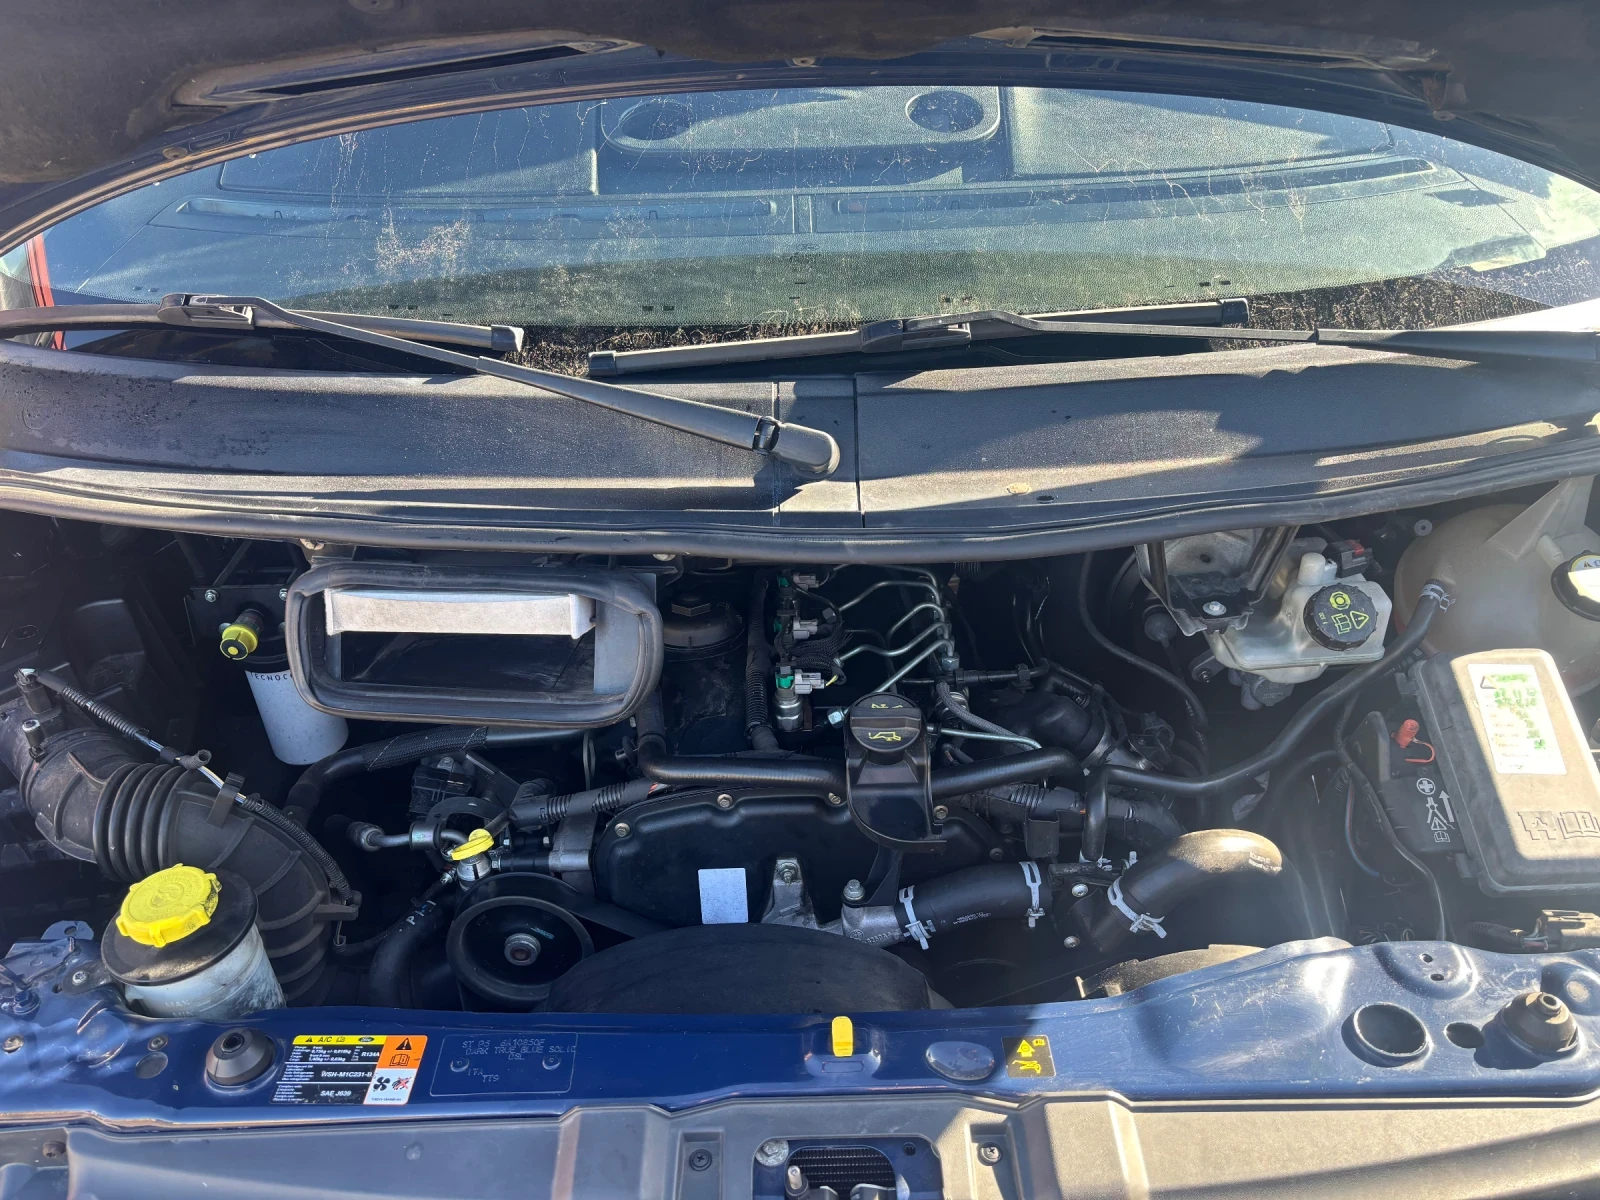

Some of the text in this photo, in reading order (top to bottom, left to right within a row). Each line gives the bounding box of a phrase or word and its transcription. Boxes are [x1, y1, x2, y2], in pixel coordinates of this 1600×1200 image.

[466, 1047, 488, 1055] DARK
[494, 1046, 515, 1054] TRUE
[521, 1045, 544, 1054] BLUE
